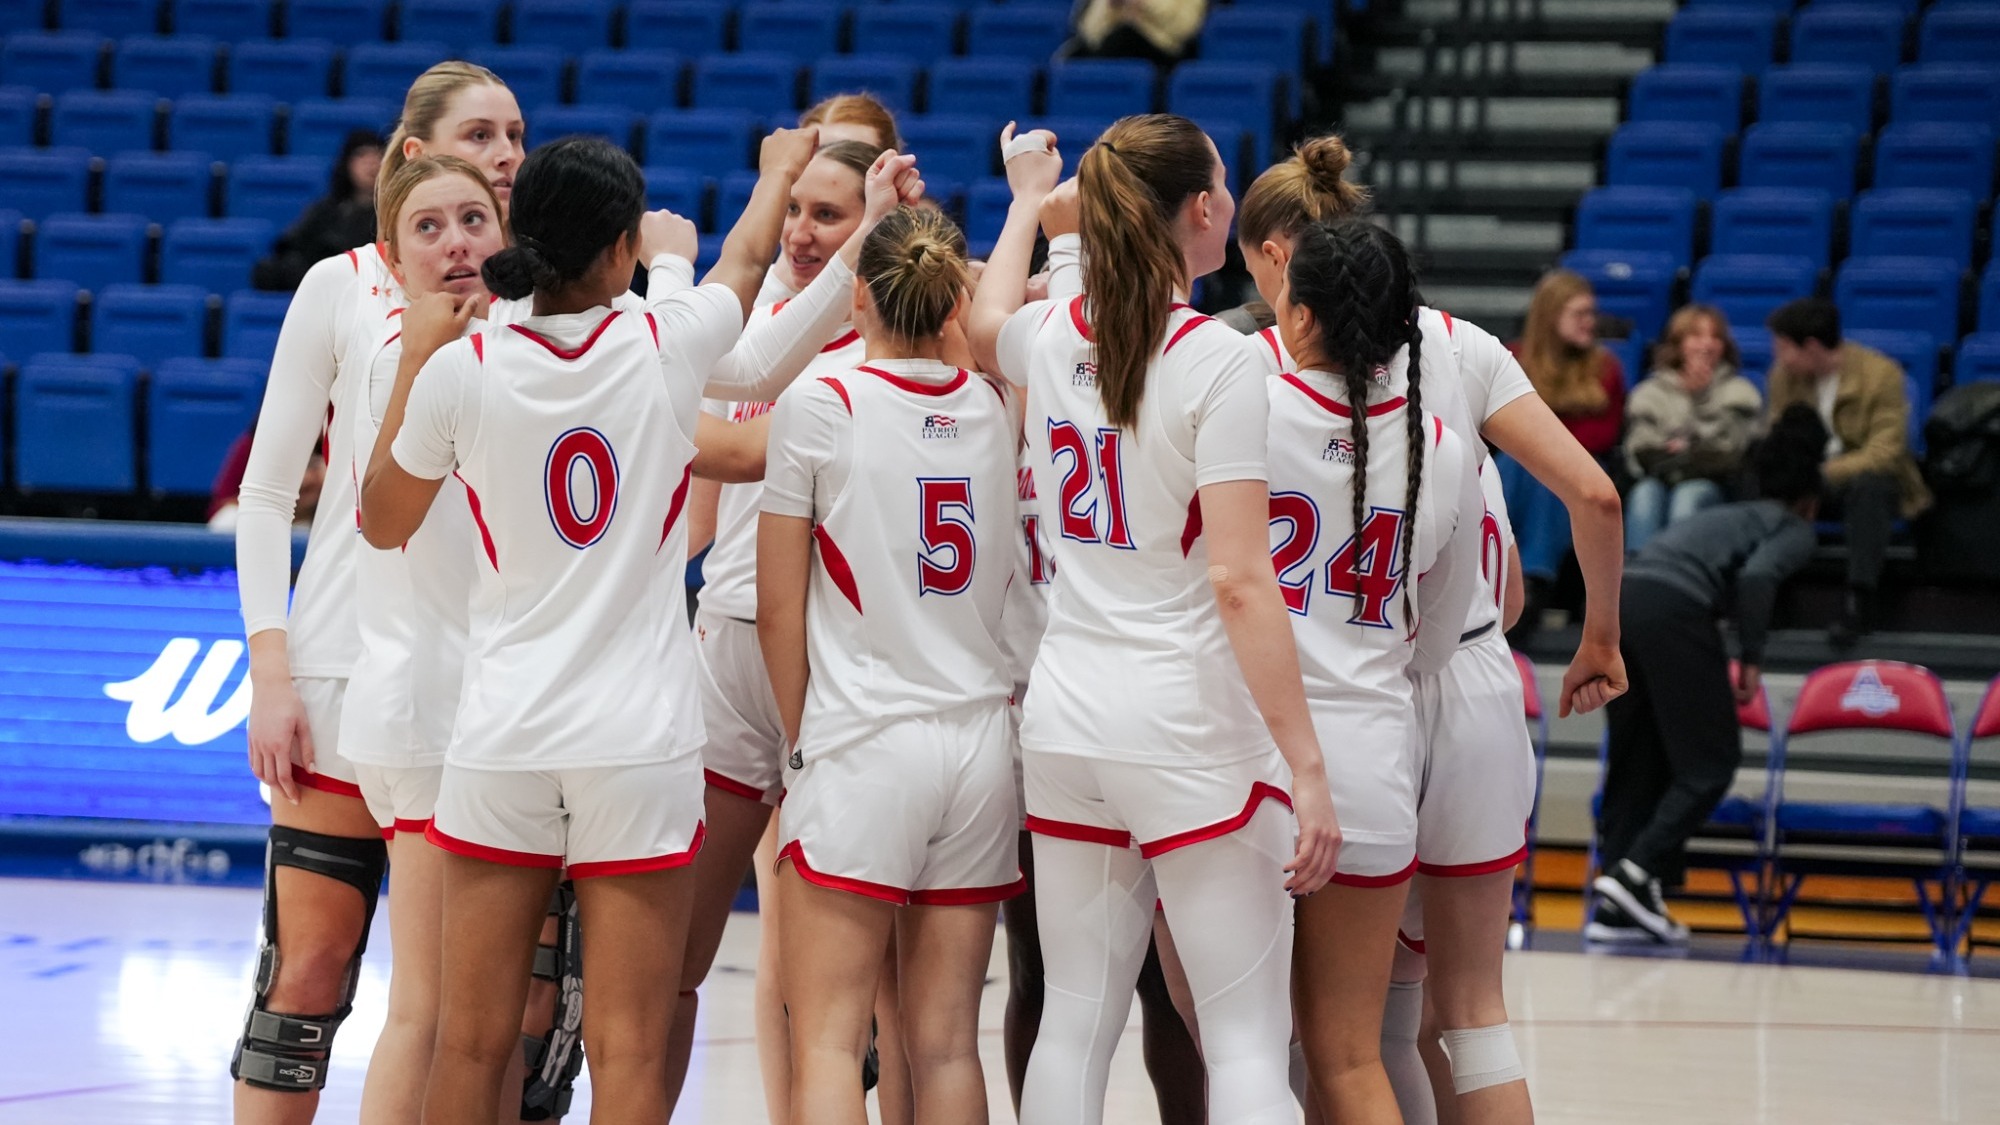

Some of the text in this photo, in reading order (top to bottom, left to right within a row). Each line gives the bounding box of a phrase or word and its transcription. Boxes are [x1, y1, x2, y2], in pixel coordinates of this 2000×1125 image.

[544, 426, 619, 550] 0
[1047, 416, 1137, 550] 21
[1323, 448, 1356, 459] PATRI
[916, 477, 976, 598] 5
[1021, 514, 1057, 586] 1
[1269, 490, 1405, 630] 24
